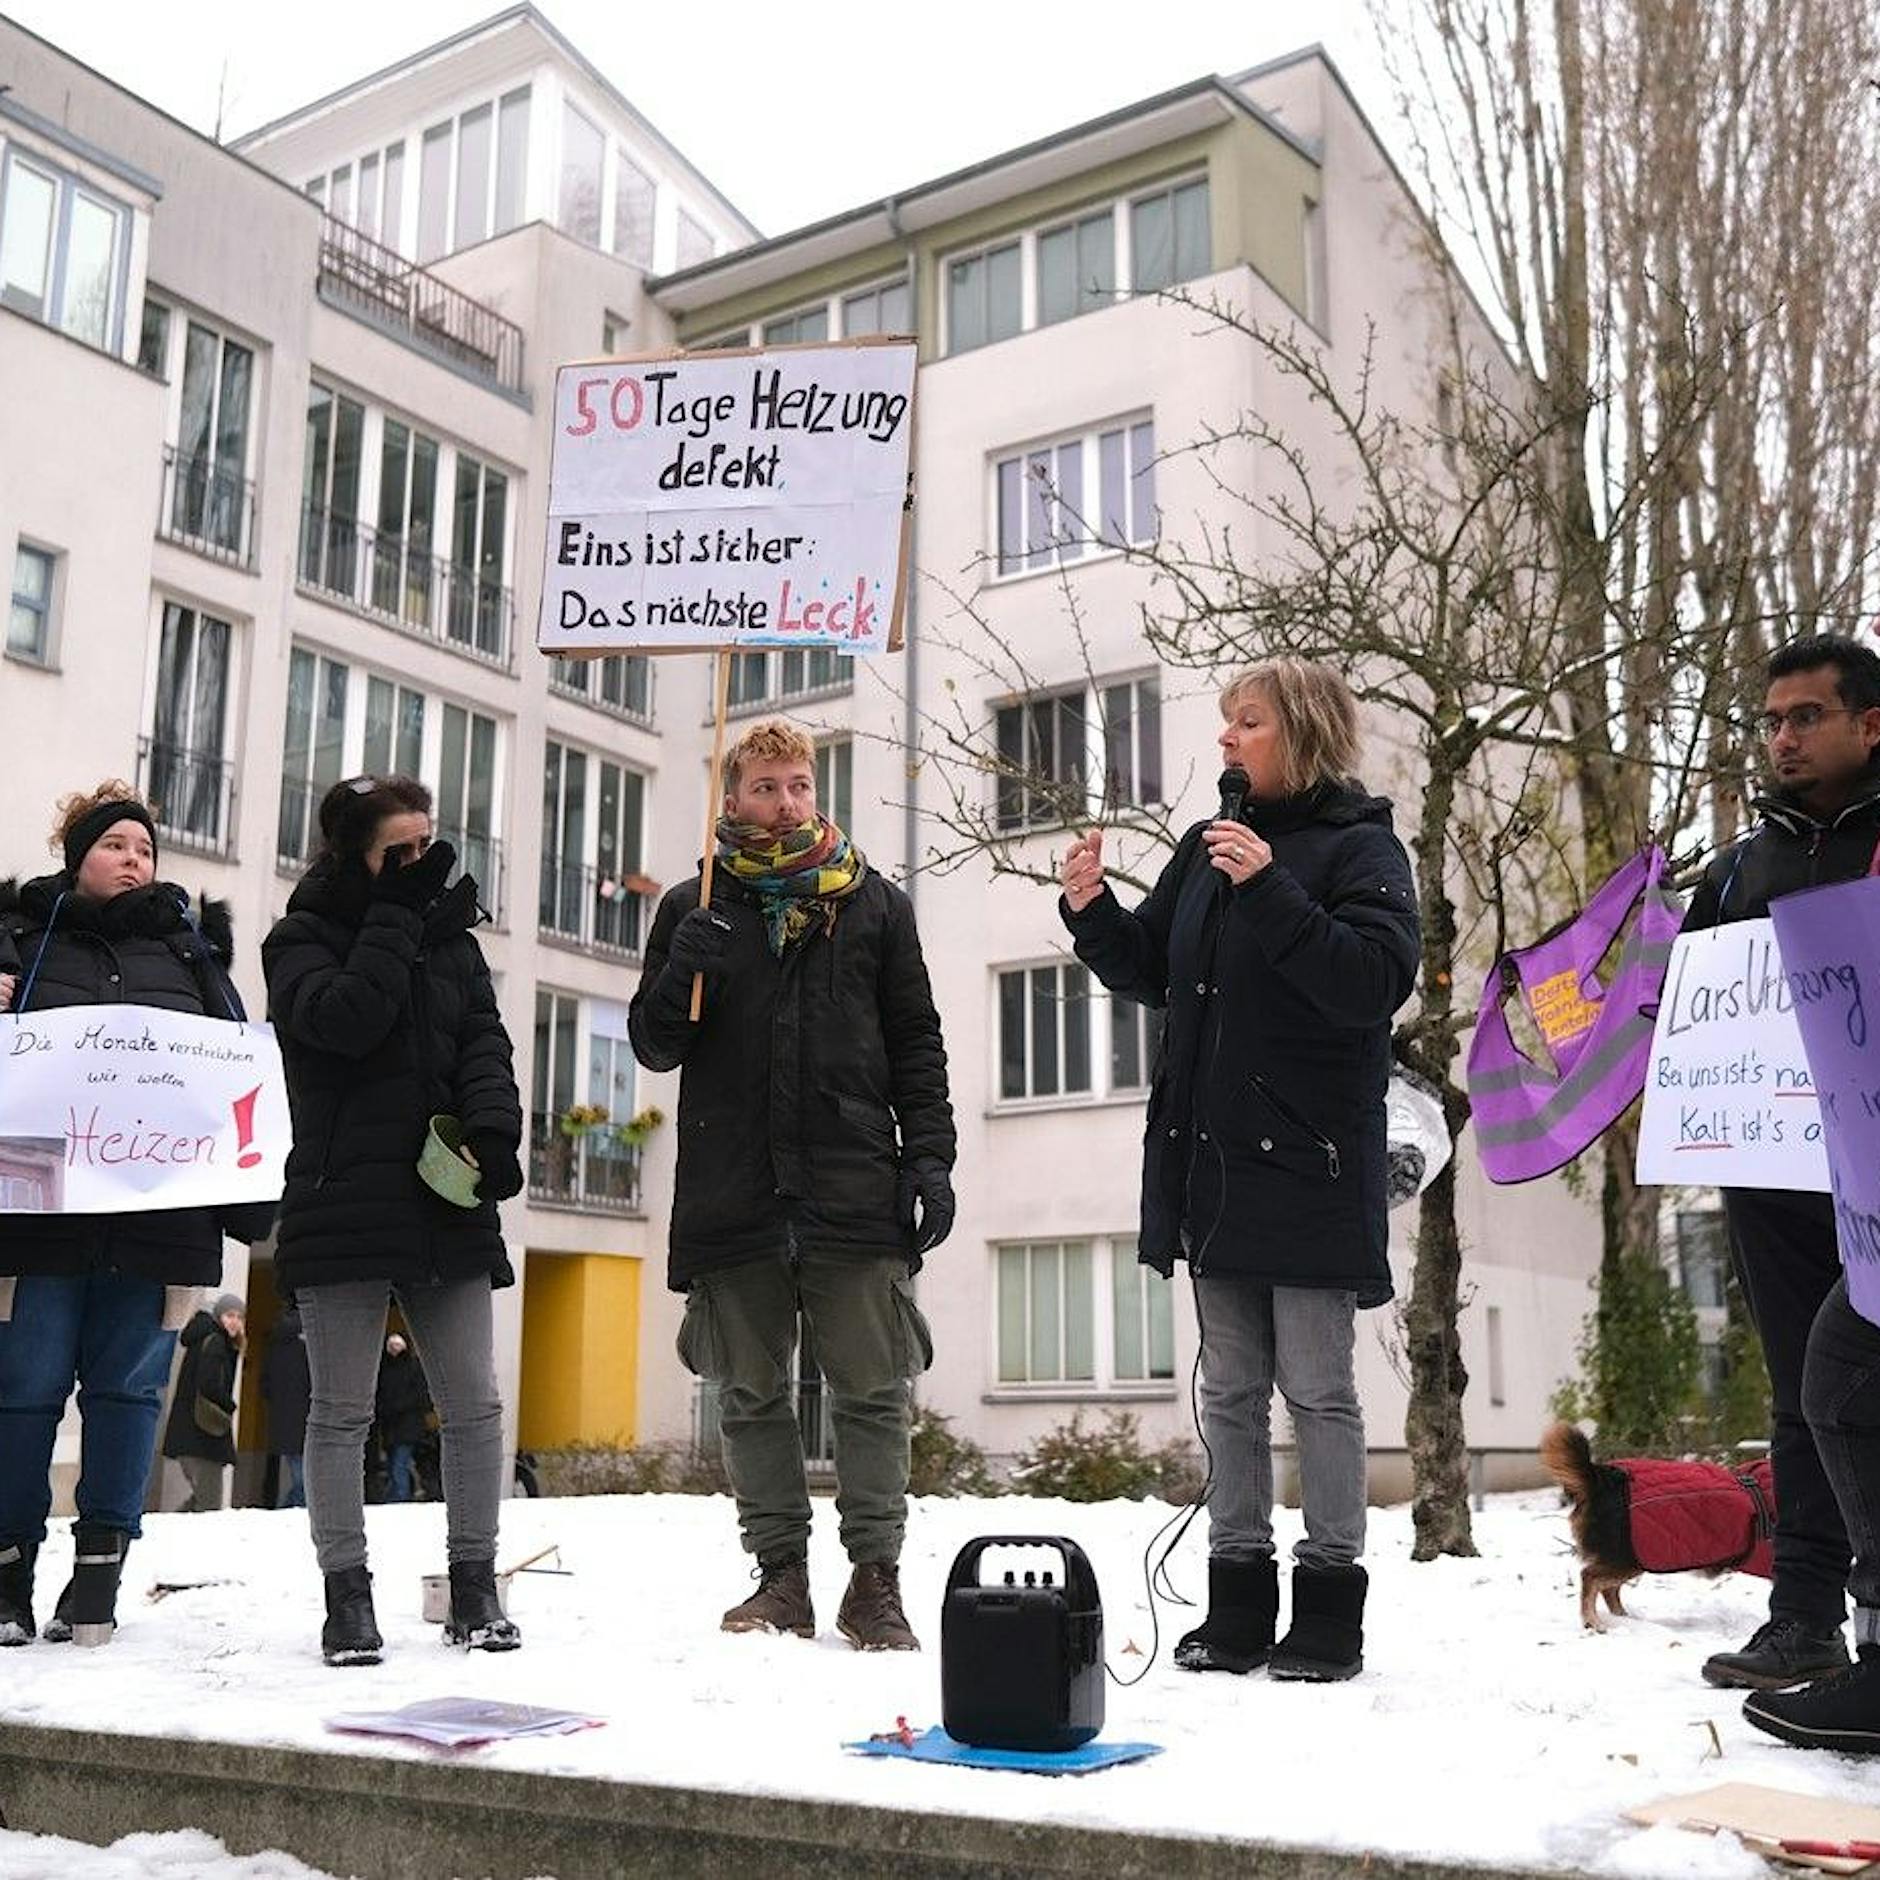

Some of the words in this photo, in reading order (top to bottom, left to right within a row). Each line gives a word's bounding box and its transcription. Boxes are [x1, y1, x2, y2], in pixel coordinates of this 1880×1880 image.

[566, 376, 643, 436] 50
[644, 371, 735, 437] Tage
[750, 369, 907, 442] Heizung
[558, 522, 632, 566] Eins
[645, 529, 684, 565] ist
[690, 528, 817, 564] sicher:
[560, 590, 636, 629] Das
[646, 588, 768, 628] nächste
[776, 577, 875, 639] Leck
[1667, 945, 1743, 1038] Lars
[9, 1031, 54, 1056] Die
[74, 1024, 159, 1051] Monate
[87, 1069, 118, 1084] wir
[1680, 1105, 1731, 1142] Kalt
